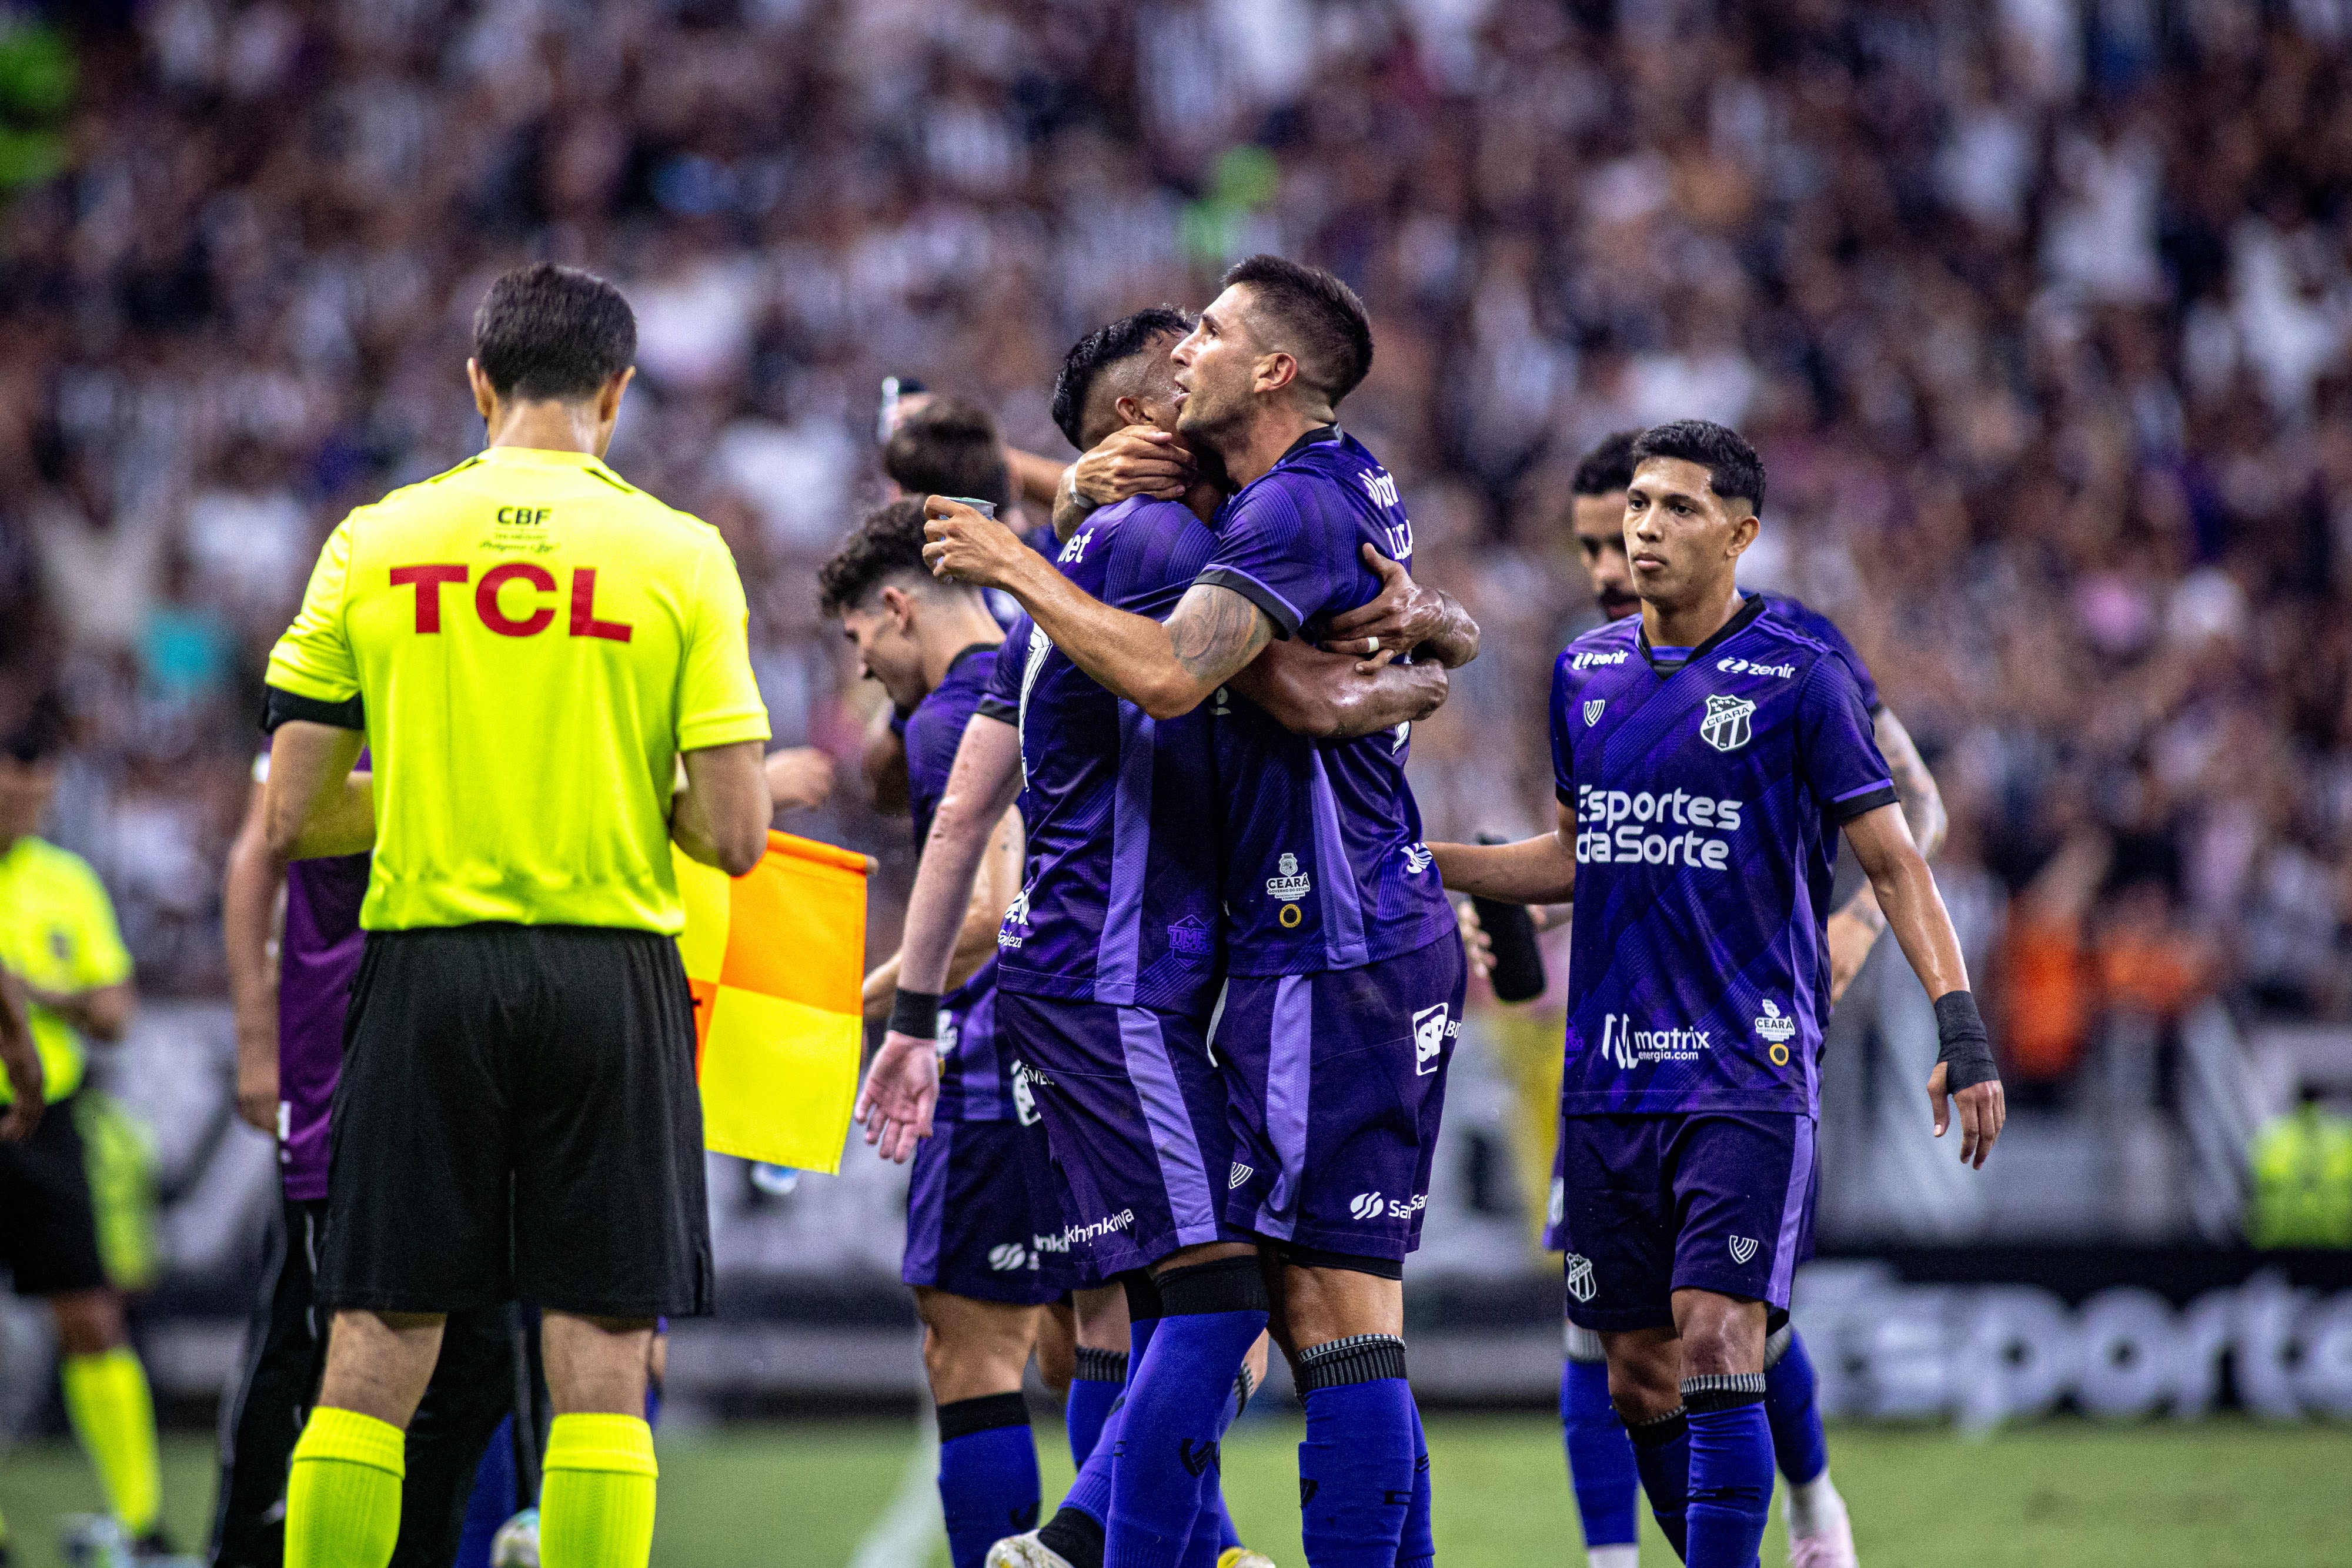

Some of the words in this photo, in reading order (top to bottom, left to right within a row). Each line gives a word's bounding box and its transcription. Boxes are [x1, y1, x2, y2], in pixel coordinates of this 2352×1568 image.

[497, 507, 552, 525] CBF
[390, 562, 632, 643] TCL
[1592, 650, 1629, 665] zenir
[1748, 663, 1795, 678] zenir
[1579, 784, 1743, 831] Esportes
[1268, 874, 1309, 888] CEARÁ
[1635, 1026, 1710, 1049] matrix
[1638, 1049, 1699, 1062] energia.com
